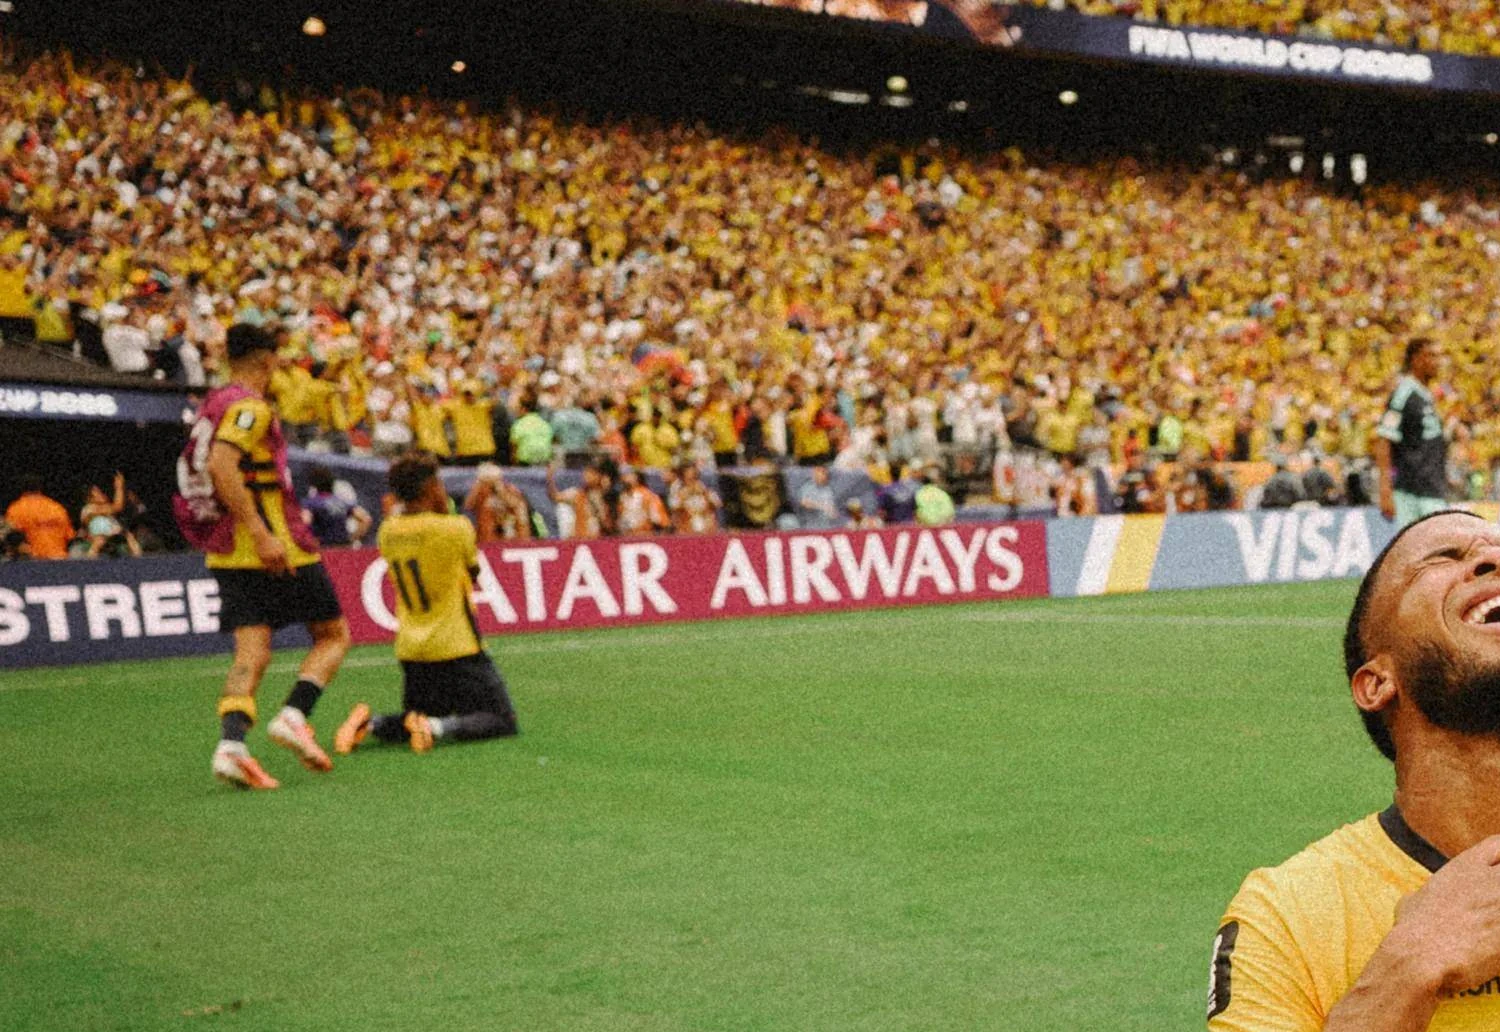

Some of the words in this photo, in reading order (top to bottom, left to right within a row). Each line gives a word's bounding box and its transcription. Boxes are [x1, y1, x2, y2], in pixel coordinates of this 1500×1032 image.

[710, 526, 1024, 609] AIRWAYS
[1225, 507, 1374, 582] VISA
[392, 557, 431, 615] 11
